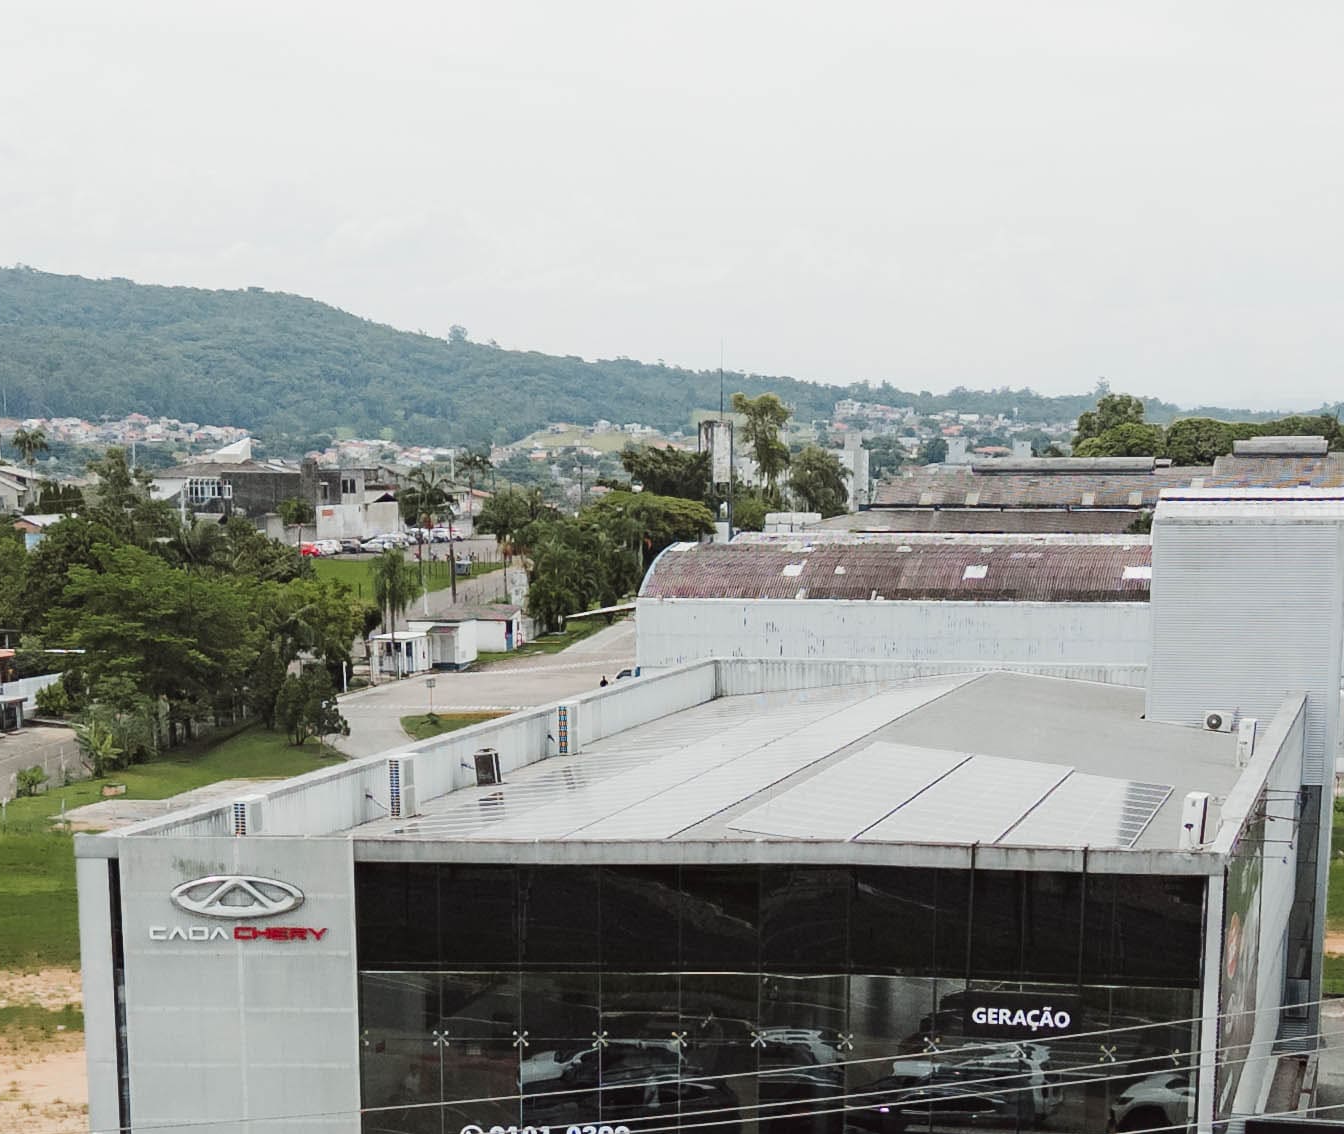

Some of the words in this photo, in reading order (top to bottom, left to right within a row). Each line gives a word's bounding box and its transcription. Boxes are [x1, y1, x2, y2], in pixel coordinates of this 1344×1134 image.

[149, 926, 229, 941] CAOA
[233, 926, 328, 941] CHERY
[971, 1006, 1071, 1032] GERAÇÃO
